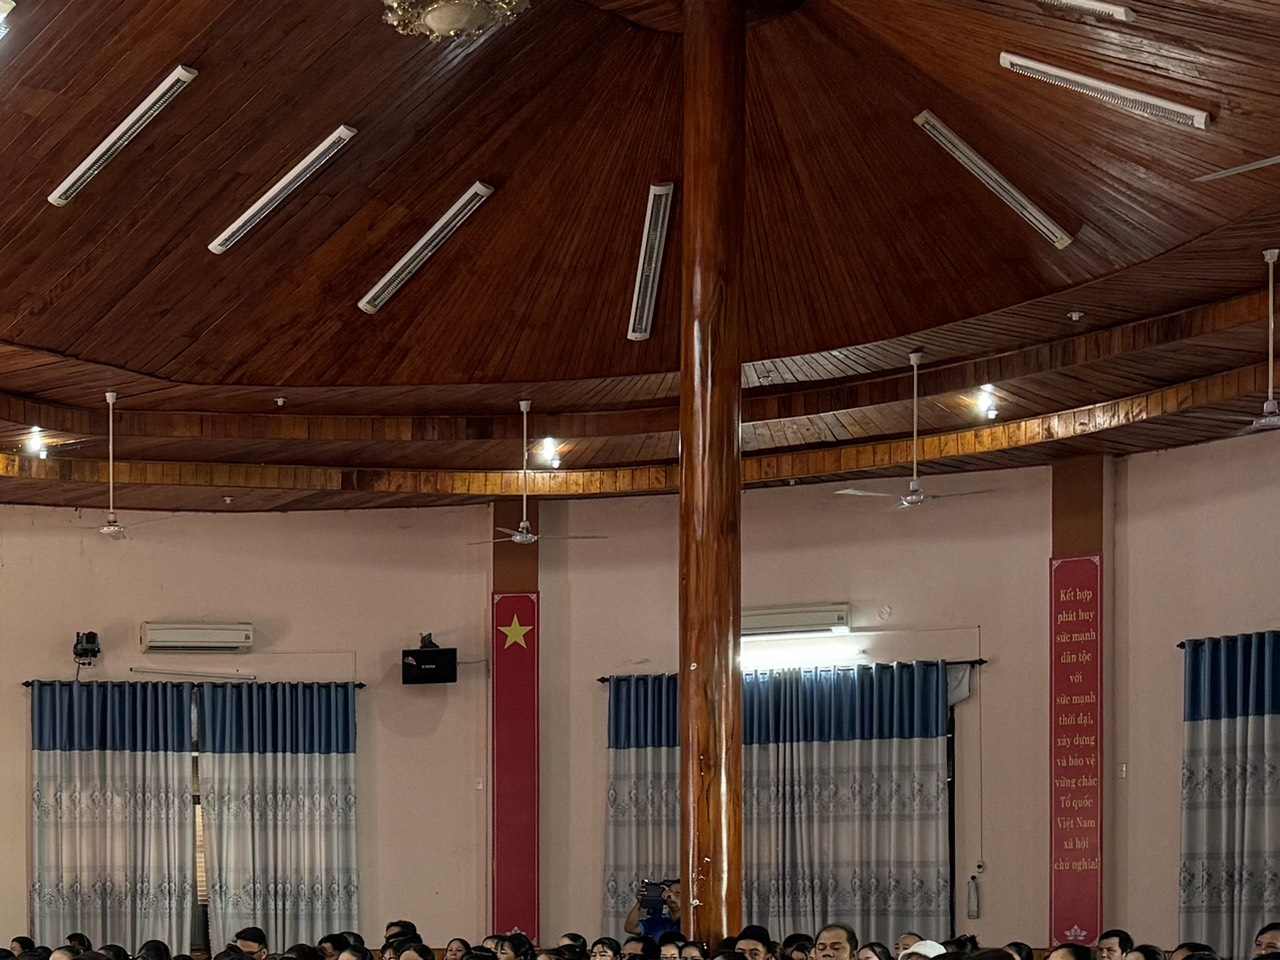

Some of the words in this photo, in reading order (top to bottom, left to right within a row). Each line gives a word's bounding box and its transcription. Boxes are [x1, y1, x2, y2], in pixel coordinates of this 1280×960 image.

[1060, 587, 1074, 602] Kết
[1076, 587, 1093, 602] hợp
[1057, 610, 1076, 625] phát
[1078, 608, 1095, 622] huy
[1072, 628, 1096, 644] mạnh
[1072, 690, 1096, 706] mạnh
[1057, 817, 1074, 831] Việt
[1076, 816, 1095, 828] Nam
